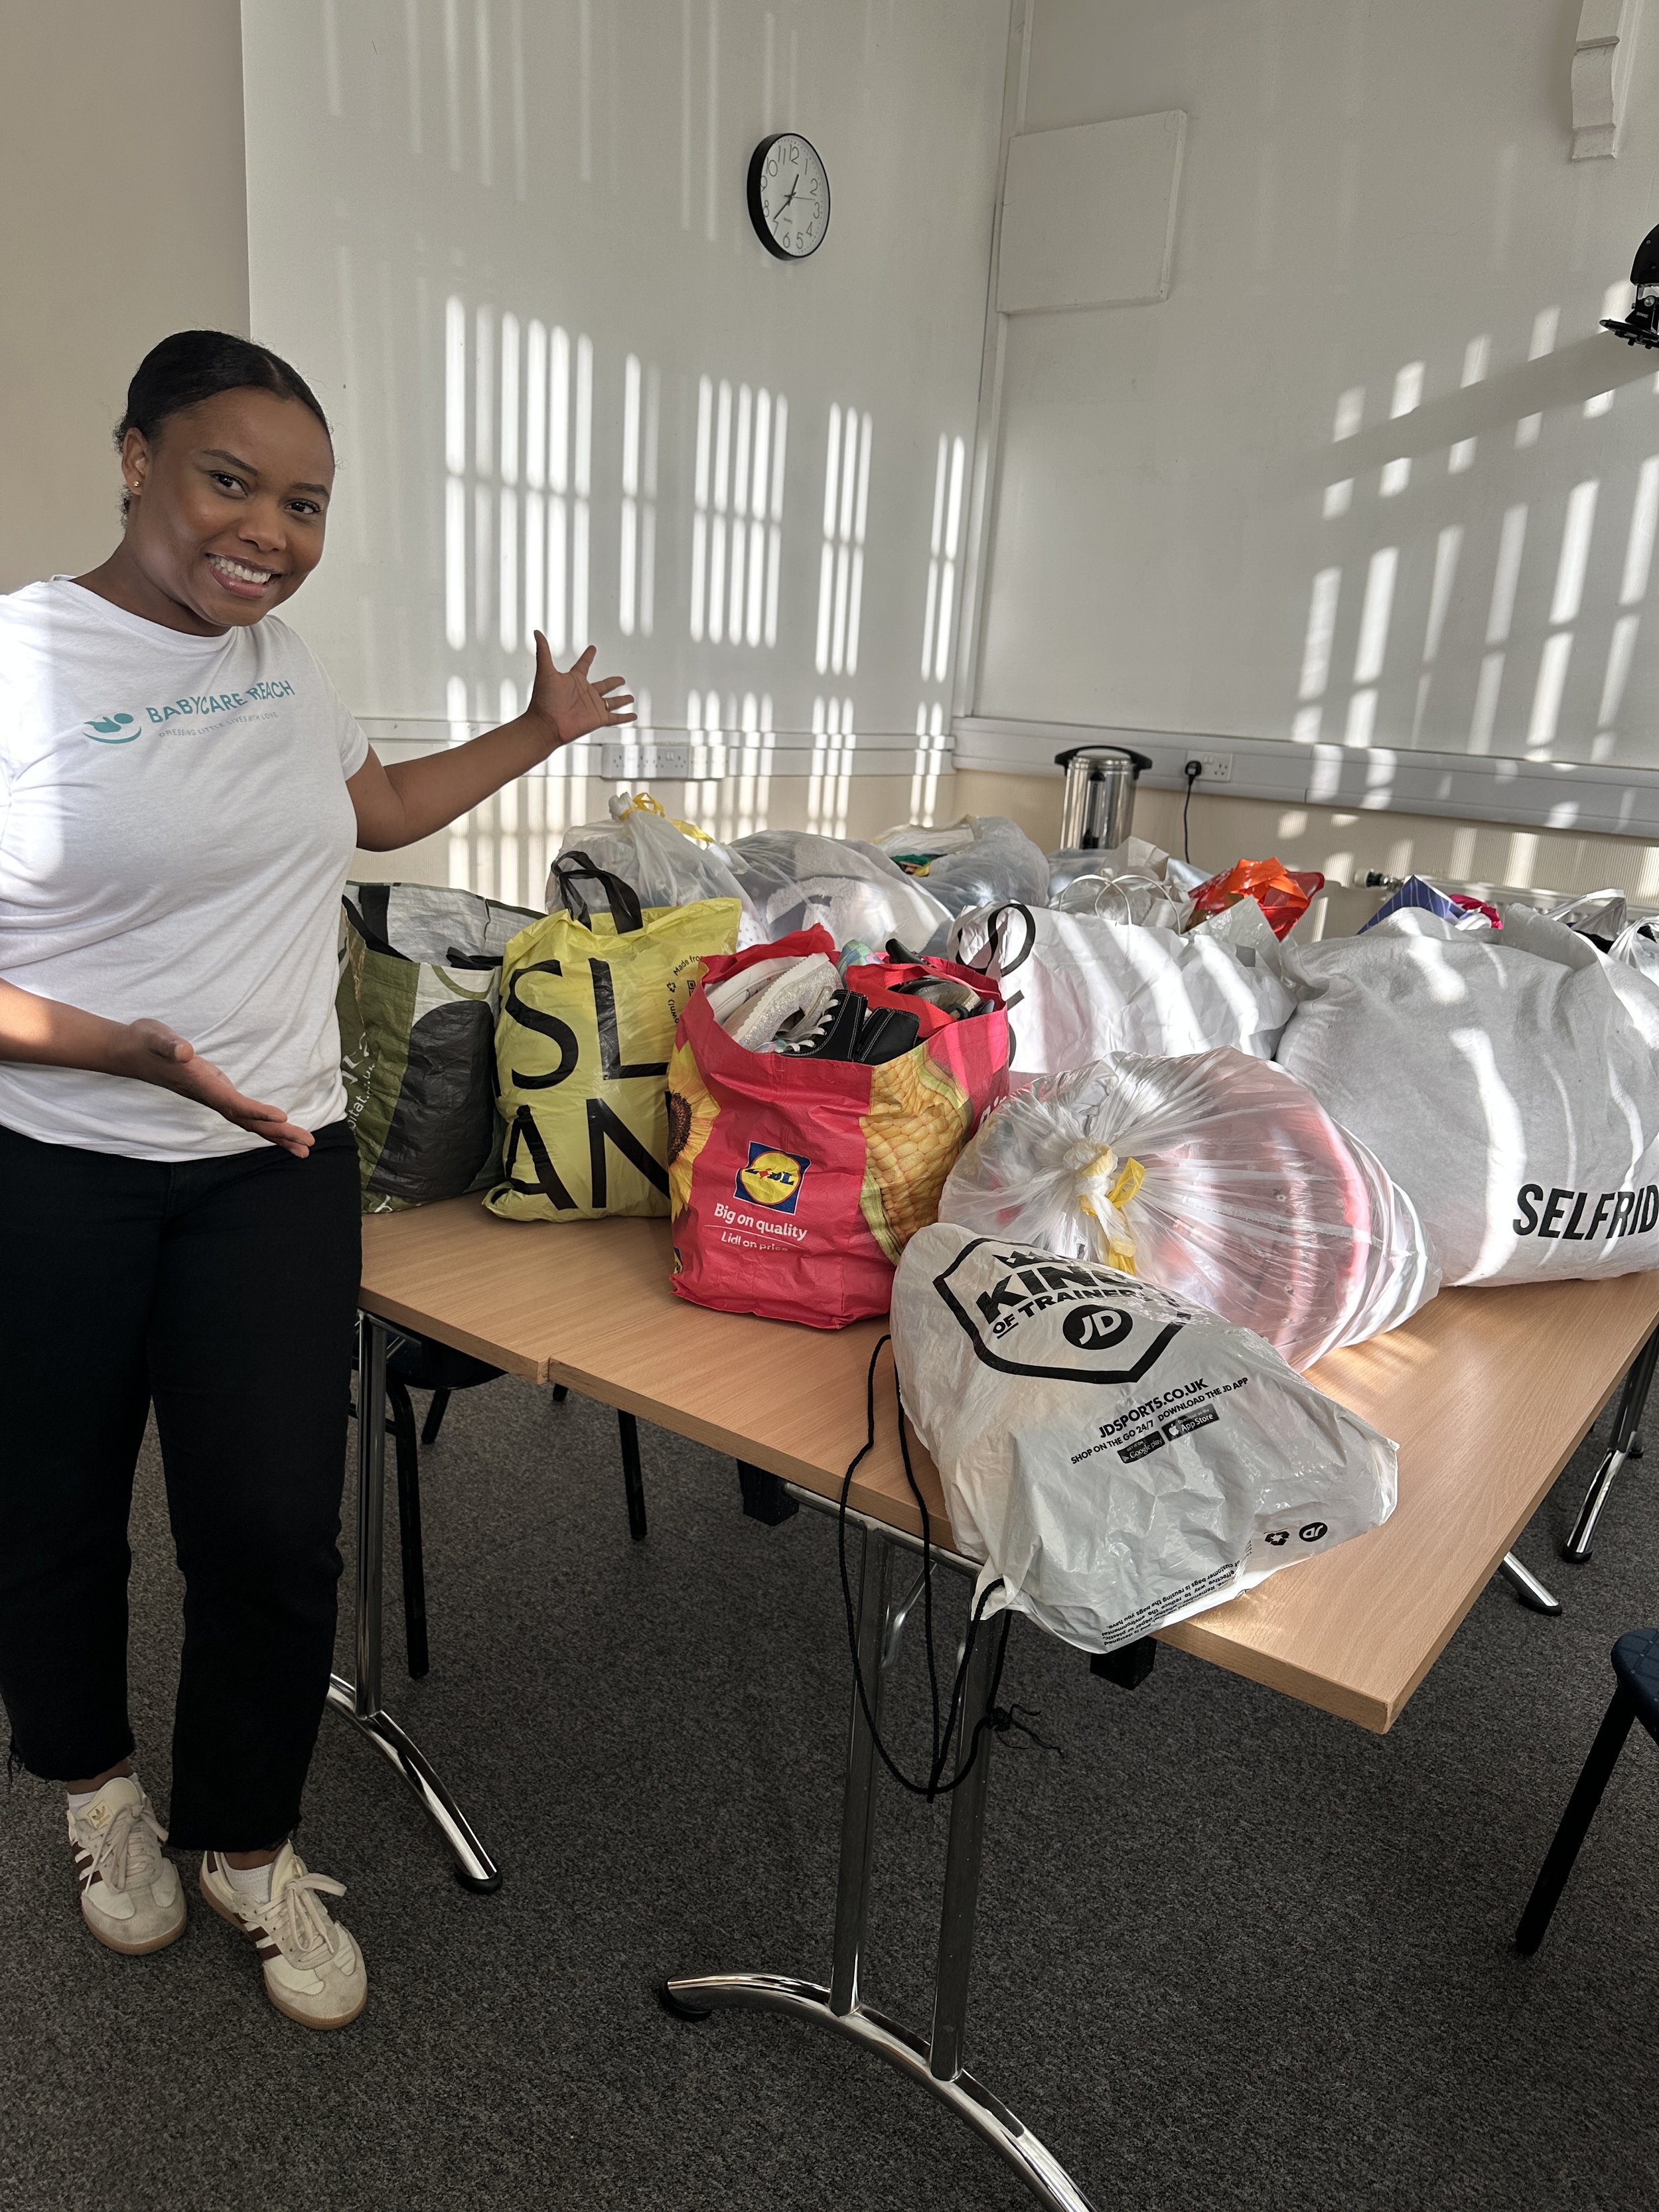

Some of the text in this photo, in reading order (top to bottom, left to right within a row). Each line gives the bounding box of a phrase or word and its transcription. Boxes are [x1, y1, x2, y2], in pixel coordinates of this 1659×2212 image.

[777, 145, 786, 165] 11
[789, 143, 800, 165] 12
[766, 157, 778, 177] 10
[804, 158, 808, 175] 1
[760, 175, 768, 192] 9
[810, 178, 818, 196] 2
[762, 200, 770, 218] 8
[813, 202, 820, 219] 3
[772, 220, 779, 237] 7
[806, 222, 813, 236] 4
[782, 232, 791, 249] 6
[796, 232, 804, 250] 5
[145, 680, 295, 723] BABYCARE REACH
[159, 729, 196, 738] DRESSING
[198, 722, 225, 735] LITTLE
[226, 715, 248, 725] LIVES
[261, 711, 279, 721] LOVE
[673, 959, 689, 976] Made
[1512, 1183, 1659, 1240] SELFRID
[713, 1203, 808, 1242] Big on quality
[721, 1231, 742, 1246] Lidl
[742, 1240, 757, 1248] on
[975, 1265, 1144, 1325] KING
[992, 1313, 1018, 1335] OF
[1078, 1309, 1123, 1345] JD
[1098, 1378, 1209, 1438] JDSPORTS.CO.UK
[1070, 1376, 1249, 1465] SHOP ON THE GO 24/7 DOWNLOAD THE JD APP
[1181, 1413, 1214, 1432] App Store
[1129, 1438, 1163, 1459] Google play
[1207, 1563, 1234, 1580] customer
[1208, 1570, 1234, 1585] effective
[1191, 1578, 1206, 1587] bags
[1194, 1584, 1206, 1593] way
[1161, 1597, 1182, 1609] reduce
[1162, 1588, 1185, 1603] reusing
[1123, 1613, 1135, 1621] you
[1135, 1605, 1151, 1615] bags
[1102, 1615, 1145, 1637] environmental
[1106, 1619, 1123, 1629] have.
[1104, 1633, 1133, 1646] designed
